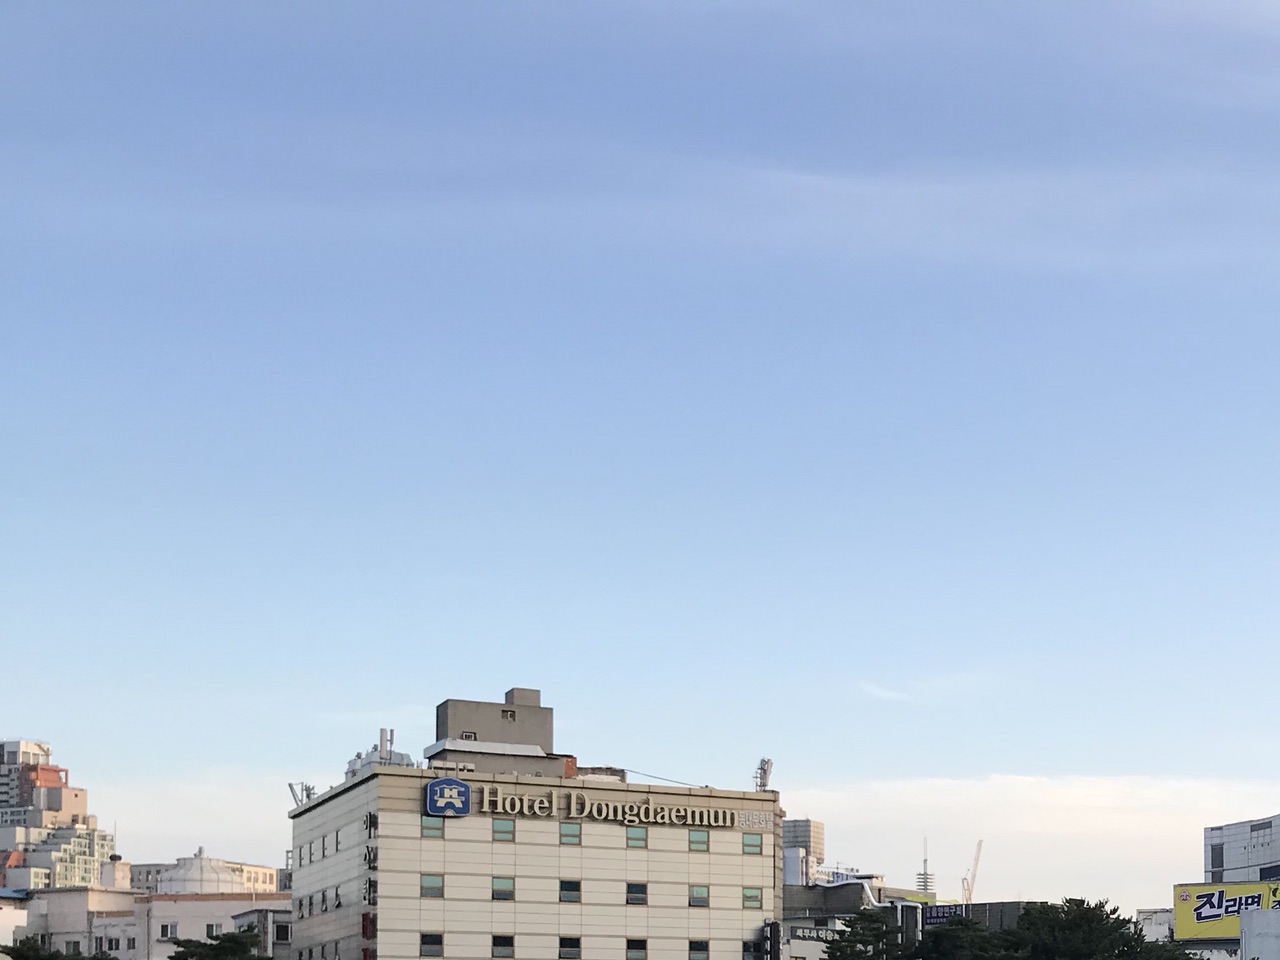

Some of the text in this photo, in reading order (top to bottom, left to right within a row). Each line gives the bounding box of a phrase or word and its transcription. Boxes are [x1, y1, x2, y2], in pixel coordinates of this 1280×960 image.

[481, 784, 738, 827] Hotel Dongdaemun
[1194, 889, 1263, 923] 진라면
[796, 928, 817, 939] 세무사
